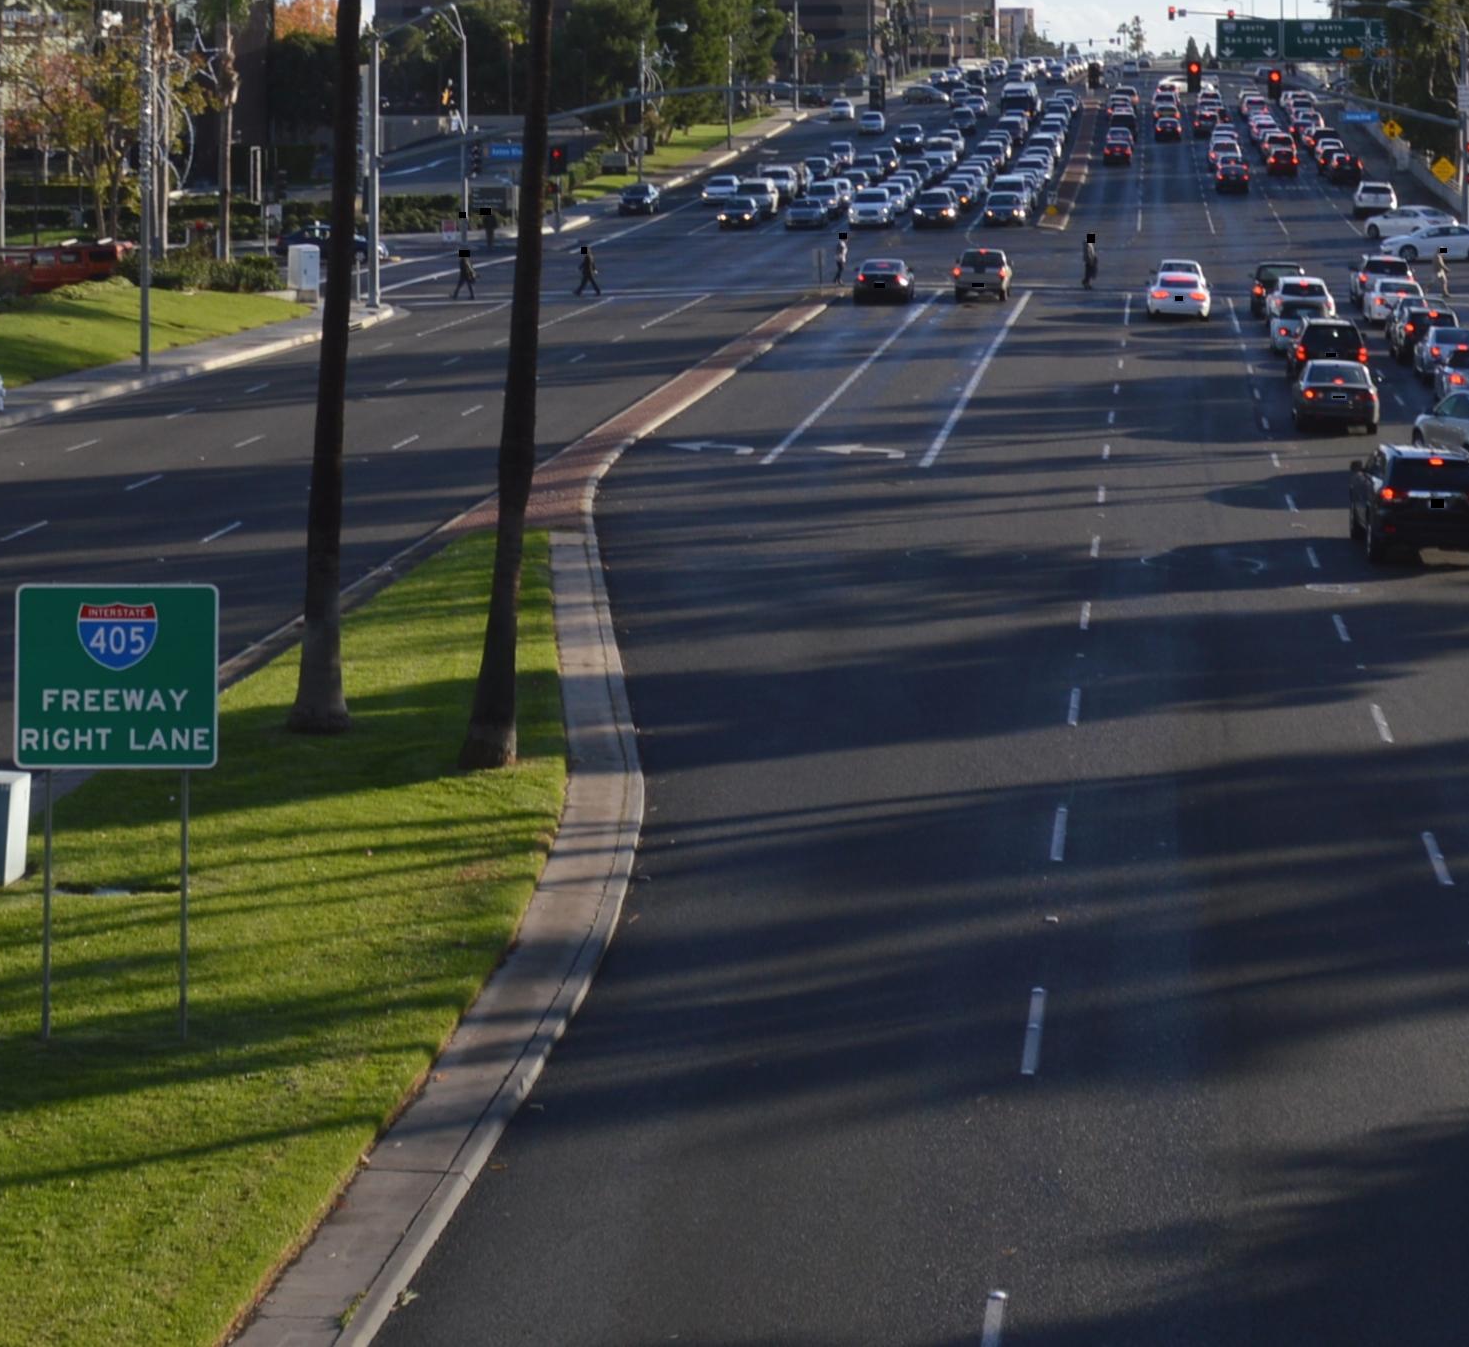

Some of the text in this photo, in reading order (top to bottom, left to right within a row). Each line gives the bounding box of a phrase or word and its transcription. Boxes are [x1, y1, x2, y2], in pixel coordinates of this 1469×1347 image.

[1246, 37, 1273, 45] Diego
[1297, 37, 1320, 46] Long
[88, 608, 147, 617] INTERSTATE
[89, 627, 145, 654] 405
[42, 689, 188, 711] FREEWAY
[21, 728, 210, 751] RIGHT LANE
